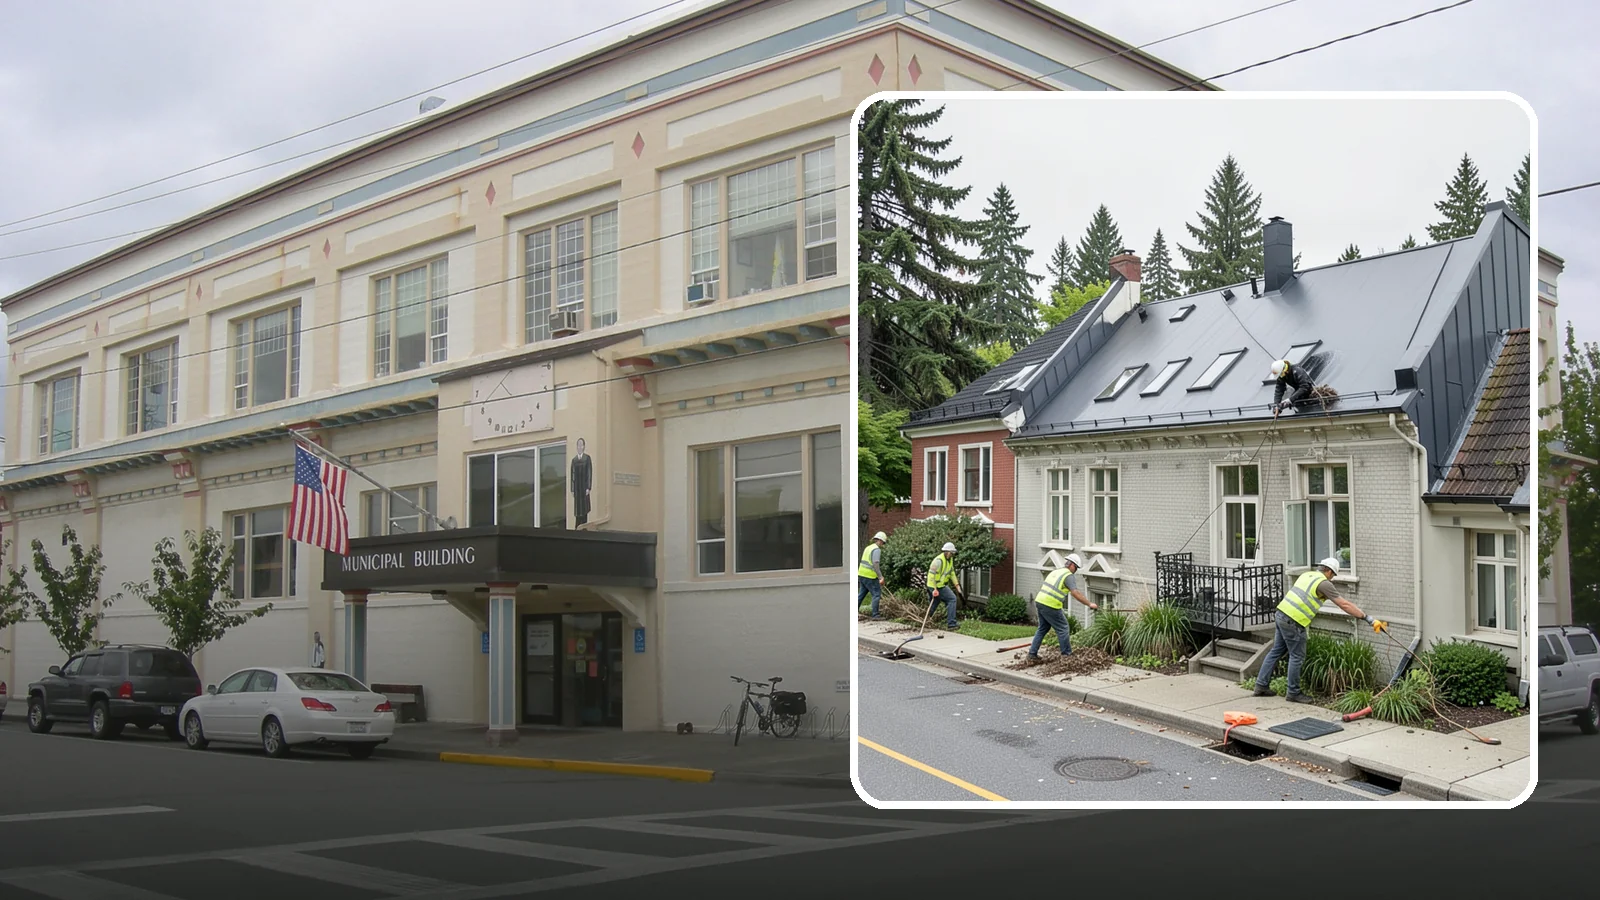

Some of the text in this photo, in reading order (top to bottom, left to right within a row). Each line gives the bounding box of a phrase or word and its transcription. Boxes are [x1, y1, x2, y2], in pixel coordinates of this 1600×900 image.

[536, 402, 540, 410] 4
[529, 414, 533, 422] 3
[508, 425, 513, 433] 12
[521, 420, 525, 428] 2
[342, 546, 475, 572] MUNICIPAL BUILDING
